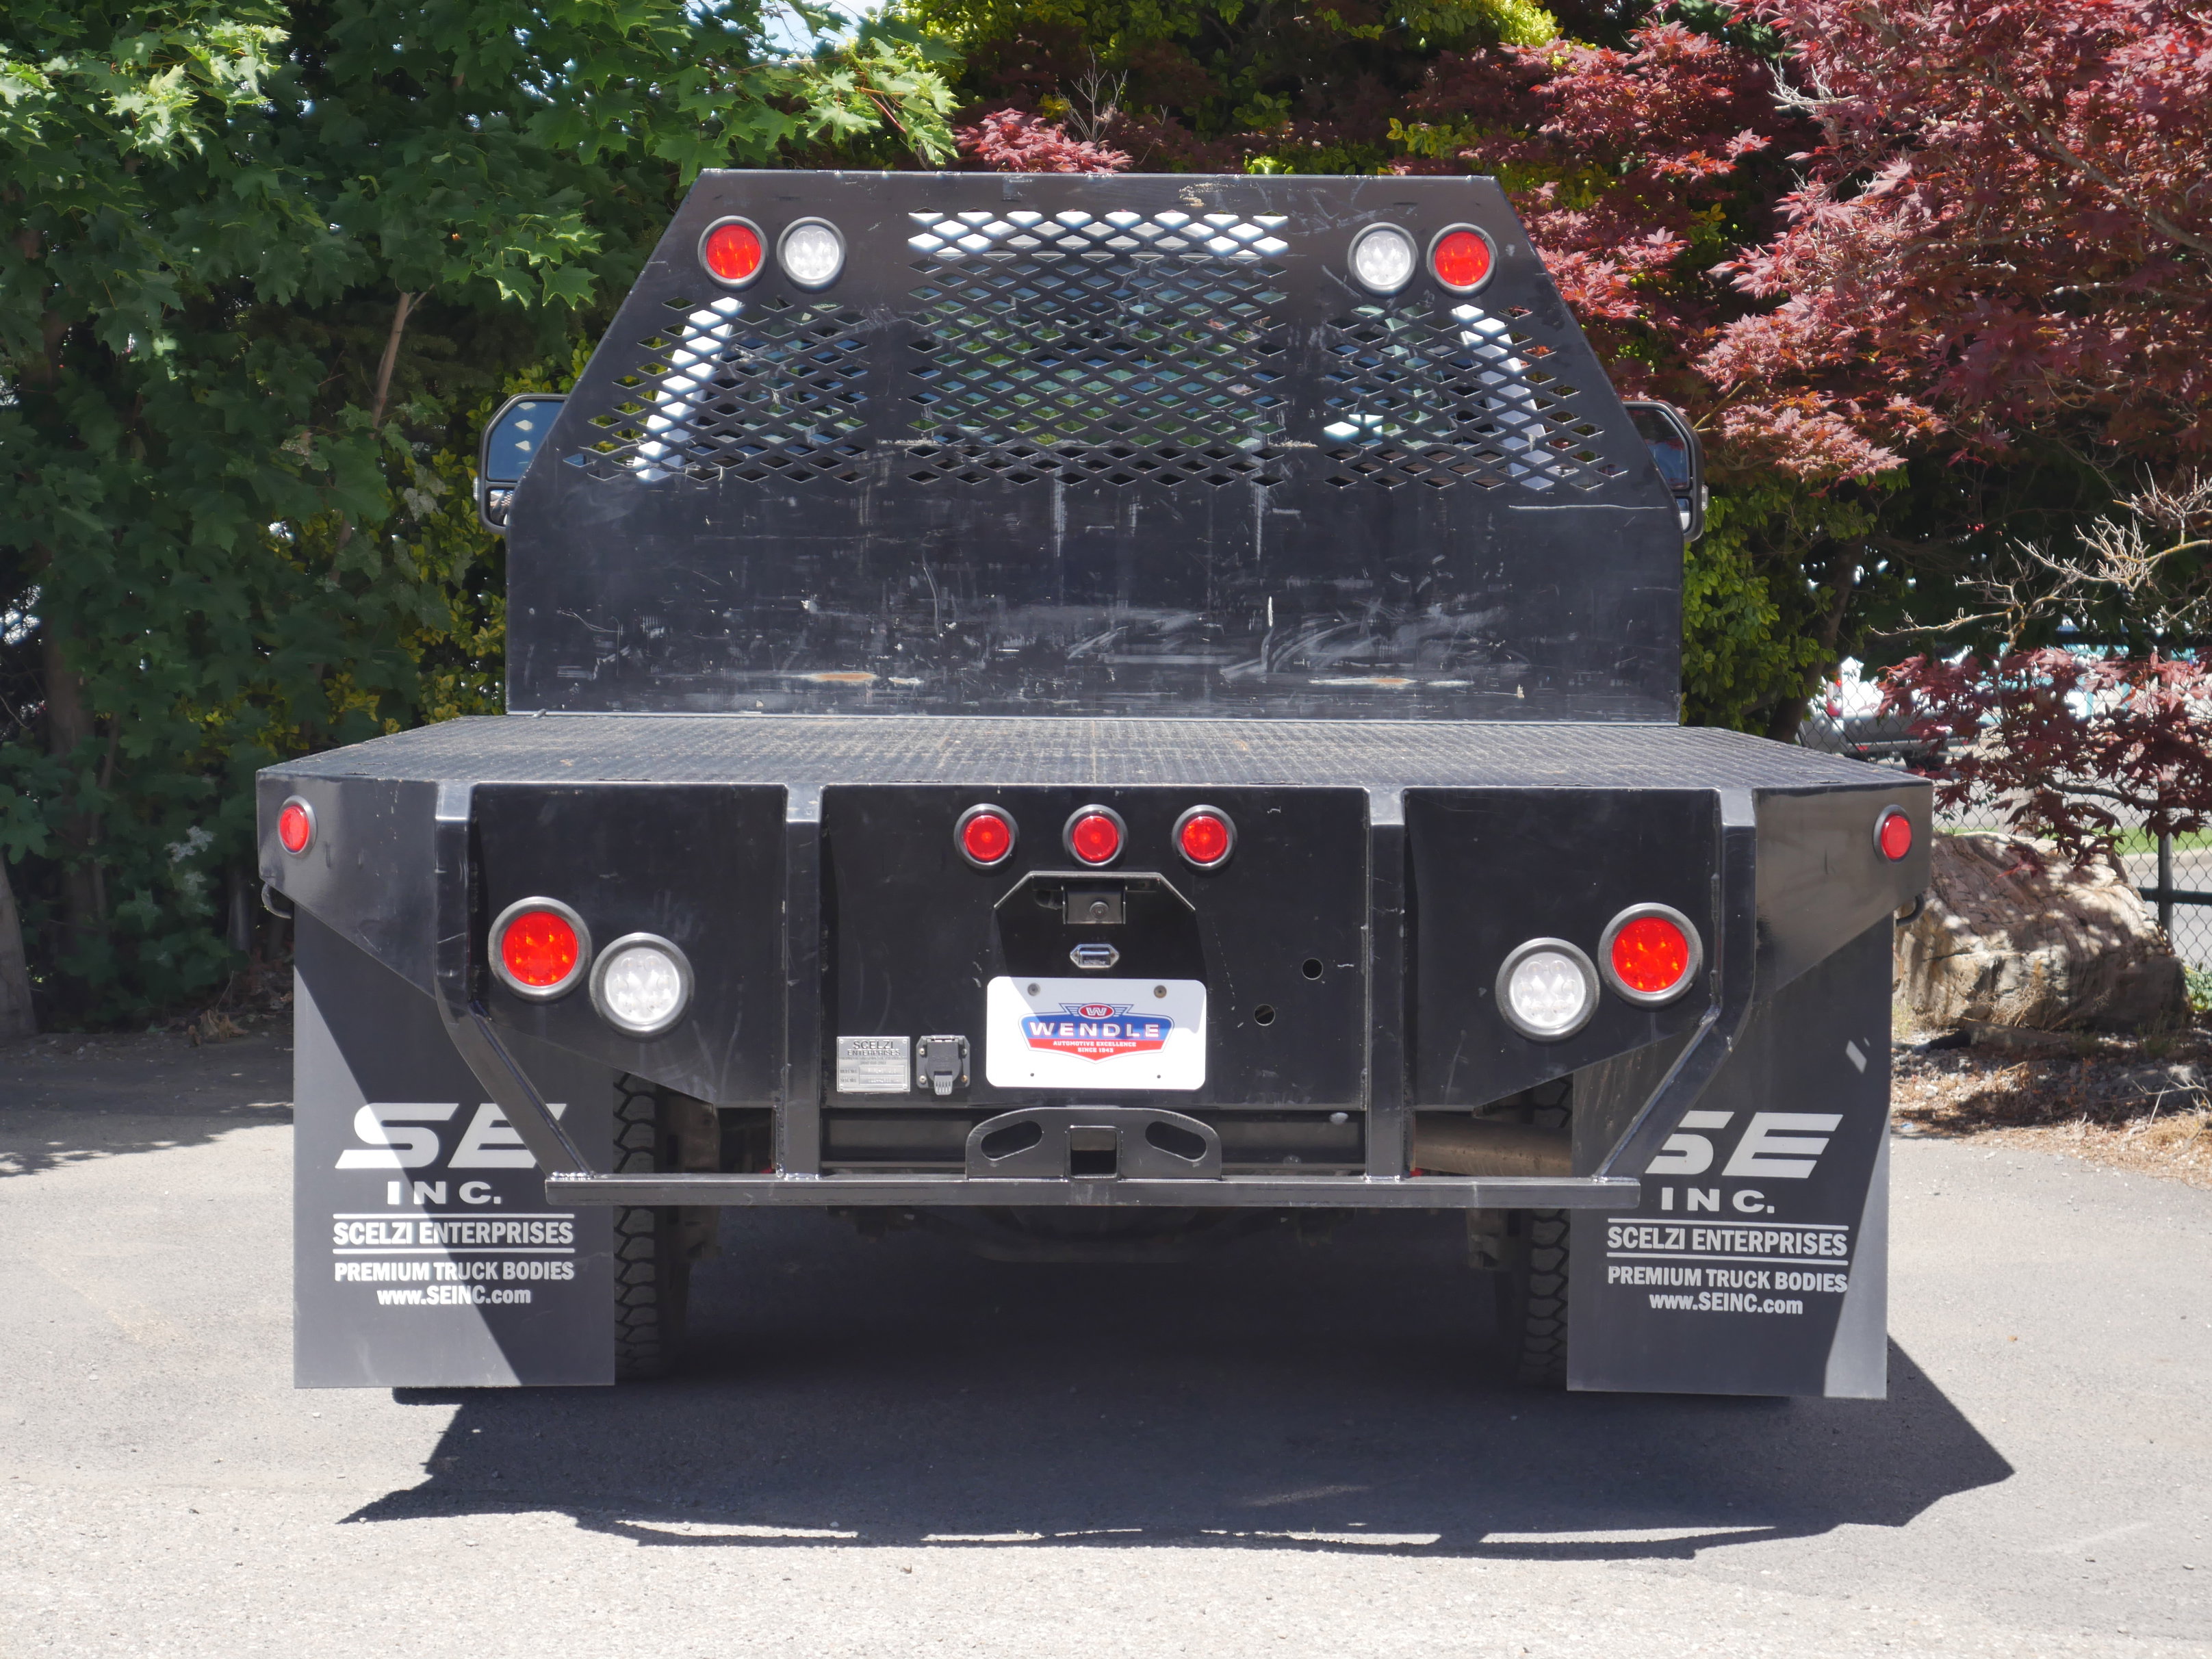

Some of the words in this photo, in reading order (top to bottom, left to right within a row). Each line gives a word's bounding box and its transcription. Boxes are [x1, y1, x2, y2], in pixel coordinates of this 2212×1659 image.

[1029, 1022, 1160, 1038] WENDLE
[853, 1040, 894, 1049] SCELZI
[387, 1181, 502, 1205] INC.
[1661, 1187, 1775, 1213] INC.
[333, 1222, 413, 1245] SCELZI
[419, 1221, 574, 1244] ENTERPRISES
[1607, 1226, 1686, 1250] SCELZI
[1692, 1229, 1848, 1257] ENTERPRISES
[335, 1262, 430, 1282] PREMIUM
[433, 1261, 498, 1281] TRUCK
[502, 1261, 575, 1281] BODIES
[1608, 1265, 1701, 1287] PREMIUM
[1706, 1269, 1771, 1289] TRUCK
[1775, 1272, 1848, 1294] BODIES
[376, 1285, 531, 1305] www.SEINC.com
[1649, 1291, 1803, 1315] www.SEINC.com
